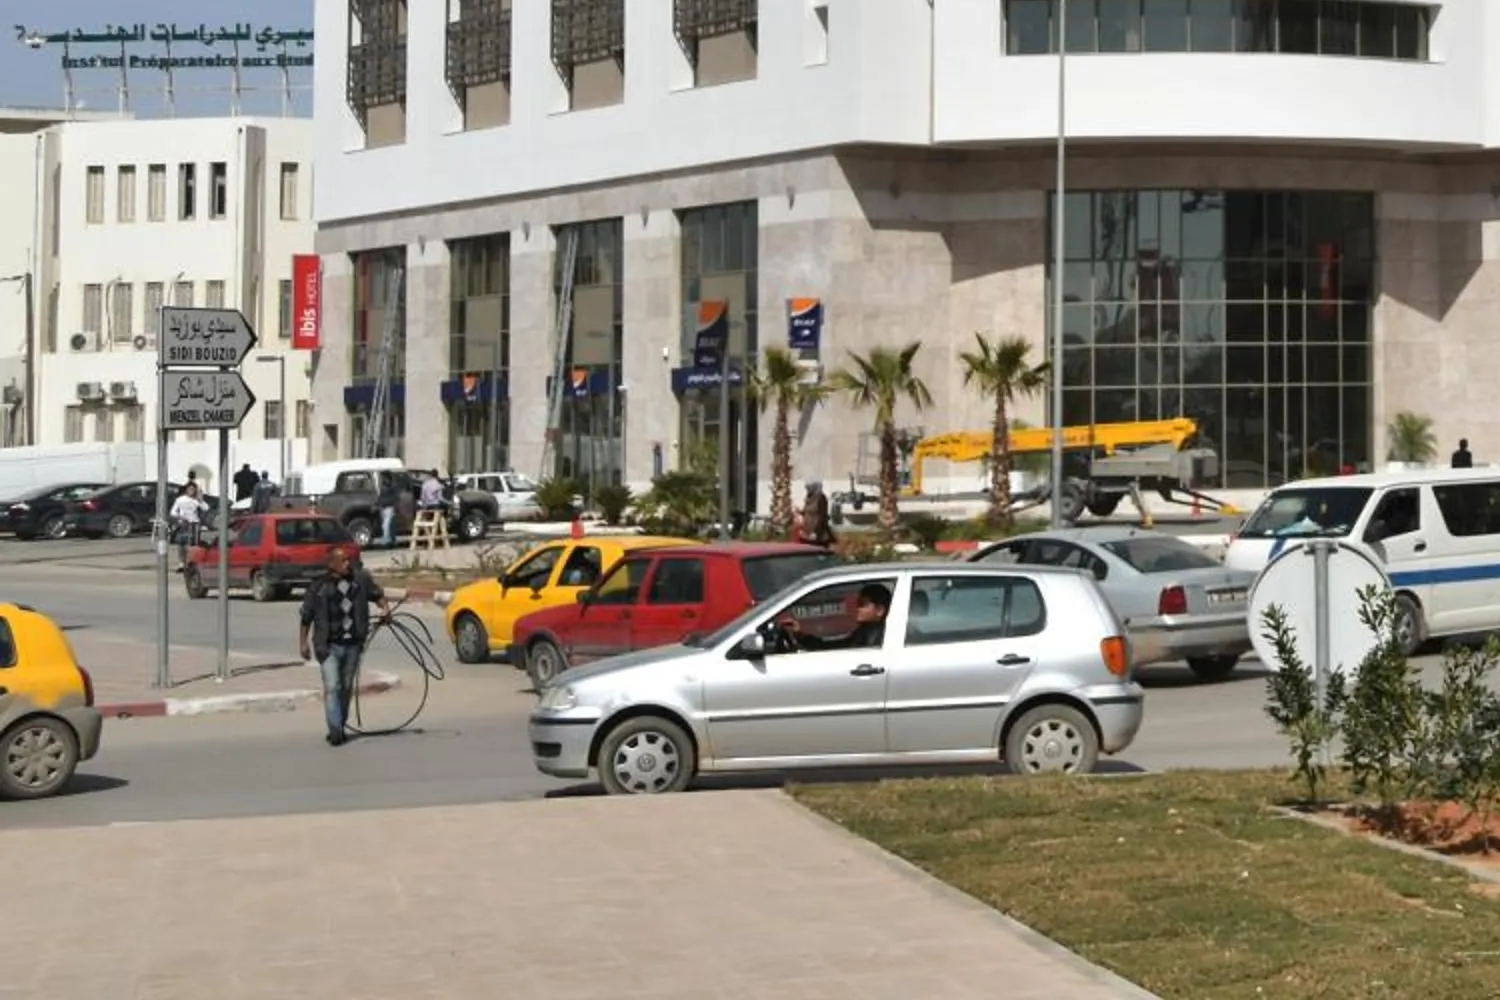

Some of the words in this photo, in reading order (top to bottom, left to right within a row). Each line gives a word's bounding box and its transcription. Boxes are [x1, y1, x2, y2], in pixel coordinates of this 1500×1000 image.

[299, 308, 316, 337] ibis
[169, 347, 193, 361] SIDI
[196, 347, 237, 361] BOUZID
[171, 376, 203, 407] شاكر
[204, 375, 235, 406] منزل
